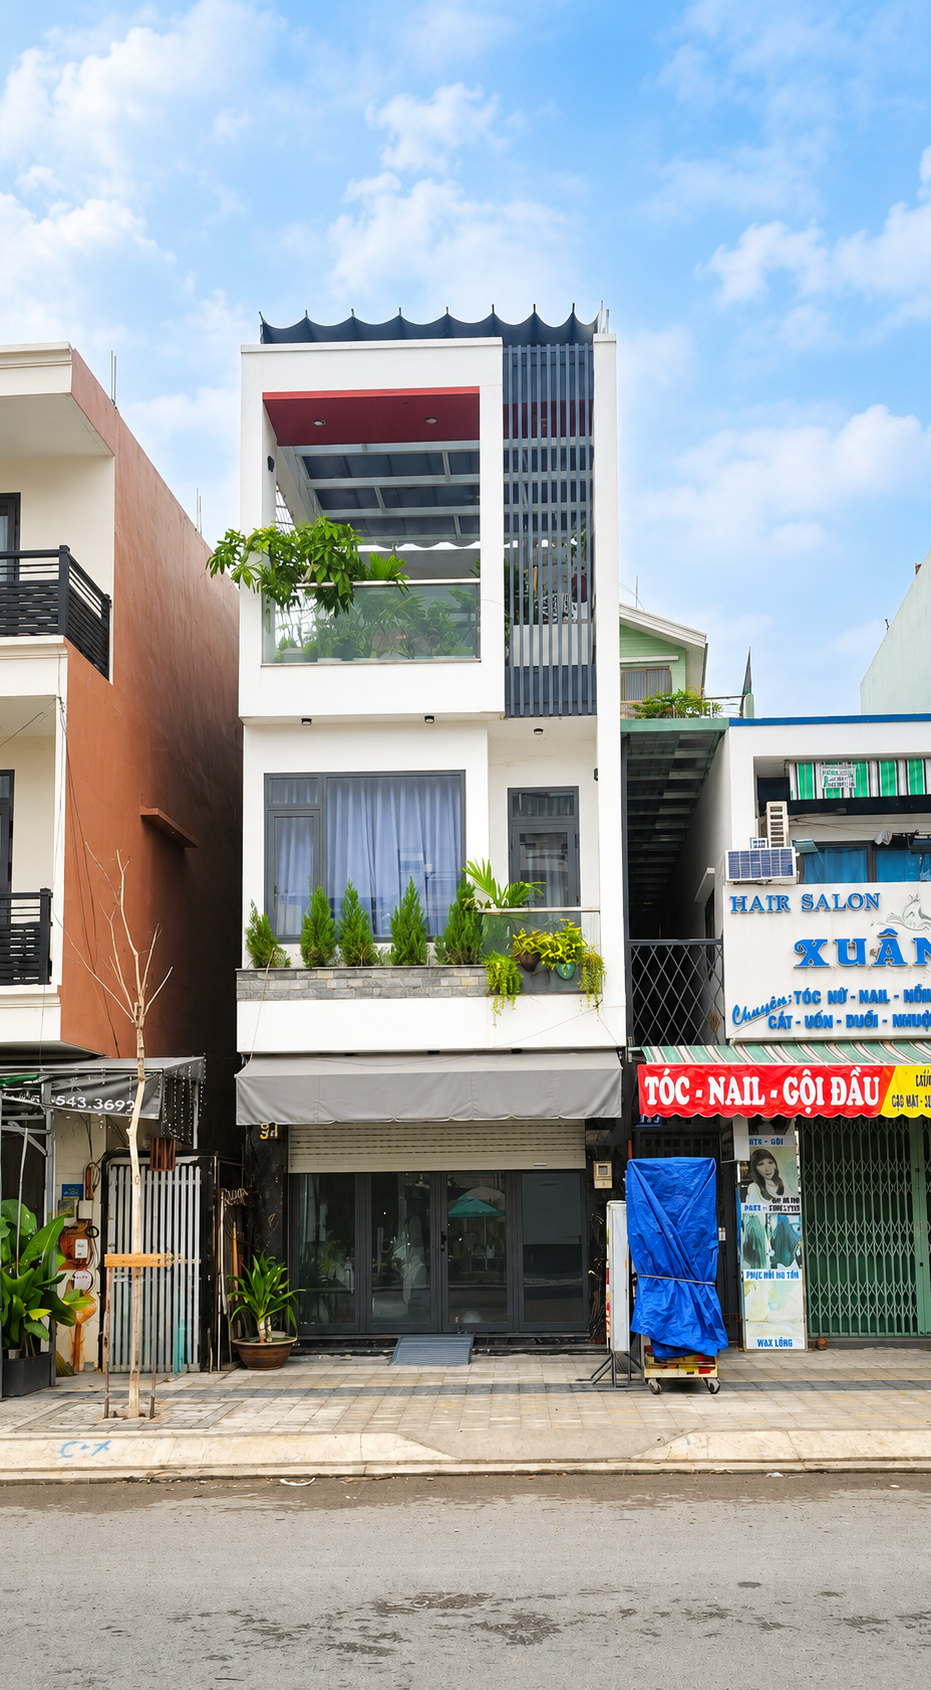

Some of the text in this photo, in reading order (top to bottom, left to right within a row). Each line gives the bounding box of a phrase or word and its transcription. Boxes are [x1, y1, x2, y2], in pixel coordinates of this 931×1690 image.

[730, 892, 881, 914] HAIR SALON
[793, 987, 822, 1005] TÓC
[858, 989, 891, 1004] NAIL
[644, 1068, 690, 1106] TÓC
[707, 1076, 766, 1106] NAIL
[782, 1068, 825, 1115] GỘI
[830, 1066, 880, 1106] ĐẦU
